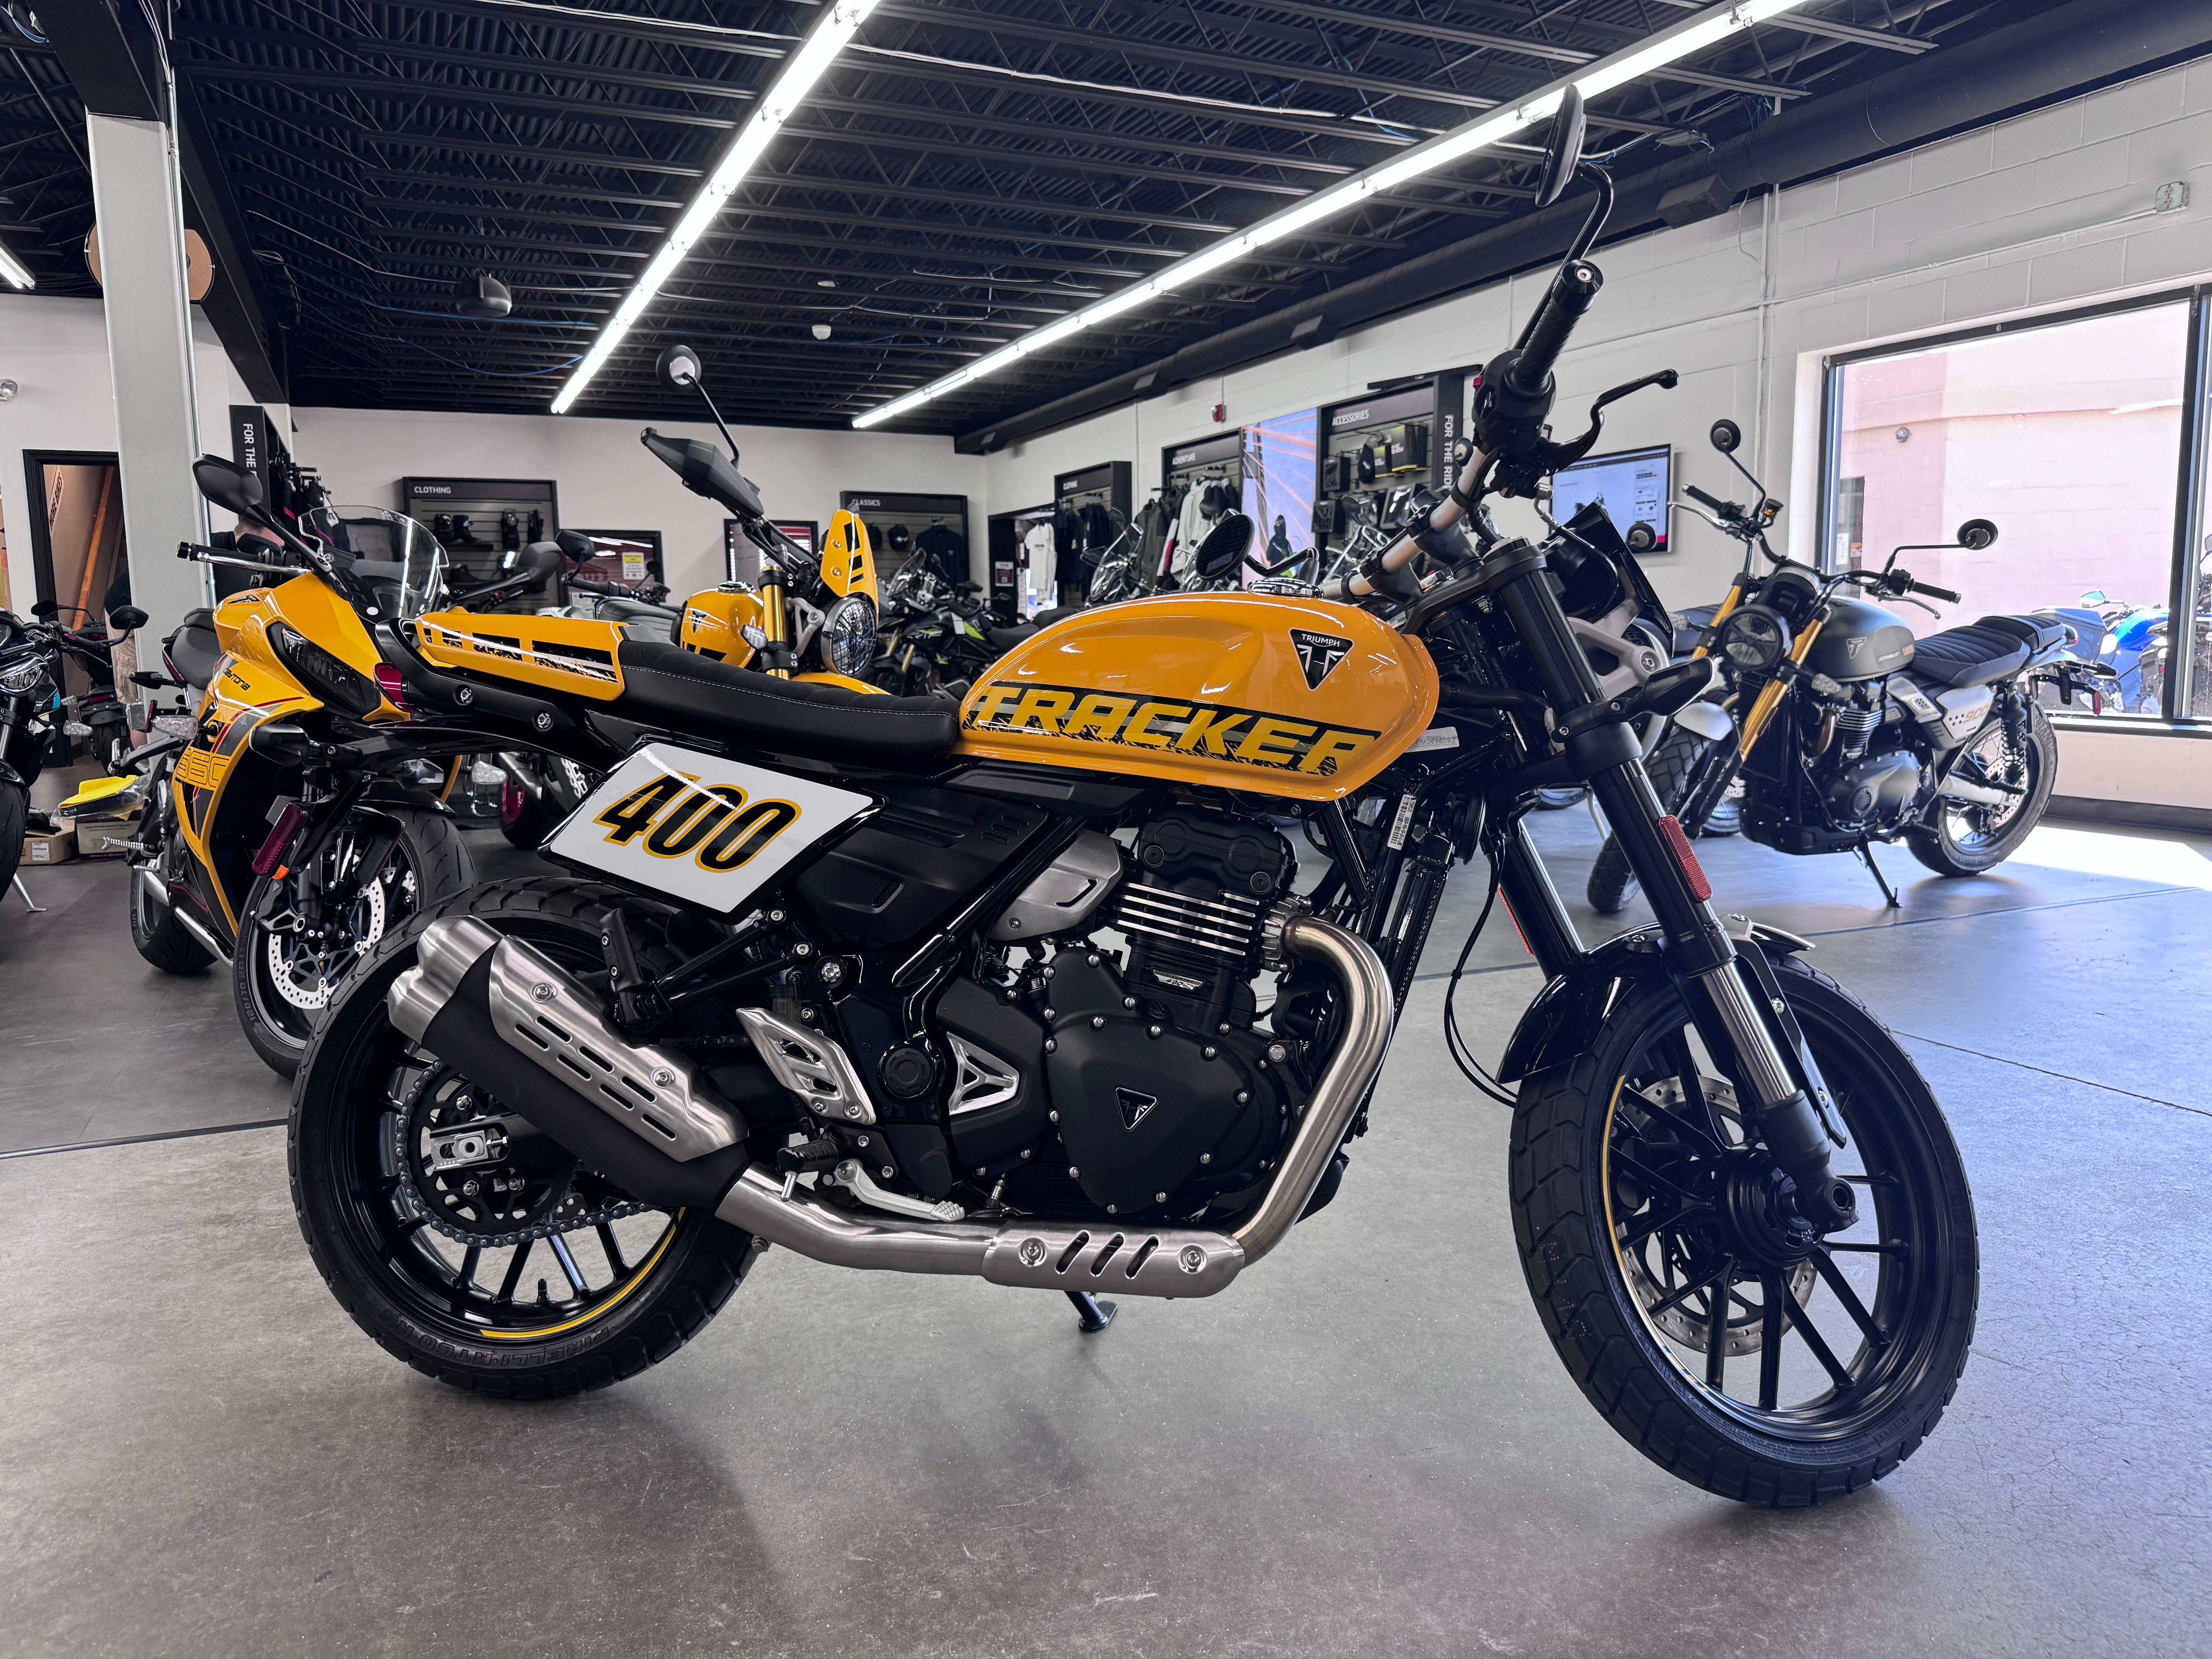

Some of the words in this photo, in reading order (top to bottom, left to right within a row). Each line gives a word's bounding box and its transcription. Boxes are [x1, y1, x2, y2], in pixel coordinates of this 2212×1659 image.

[1332, 409, 1370, 426] ACCESSORIES
[1444, 414, 1454, 438] FOR
[243, 423, 254, 444] FOR
[245, 447, 256, 468] THE
[1444, 440, 1454, 463] THE
[414, 486, 452, 494] CLOTHING
[1301, 634, 1340, 647] TRIUMPH
[1963, 705, 1989, 723] 900
[973, 685, 1376, 774] TRACKER
[592, 770, 802, 873] 400
[1166, 979, 1185, 988] 400
[239, 982, 256, 1021] 120/70
[501, 1326, 611, 1367] PIRELLI
[1609, 1279, 1688, 1396] PIRELLI
